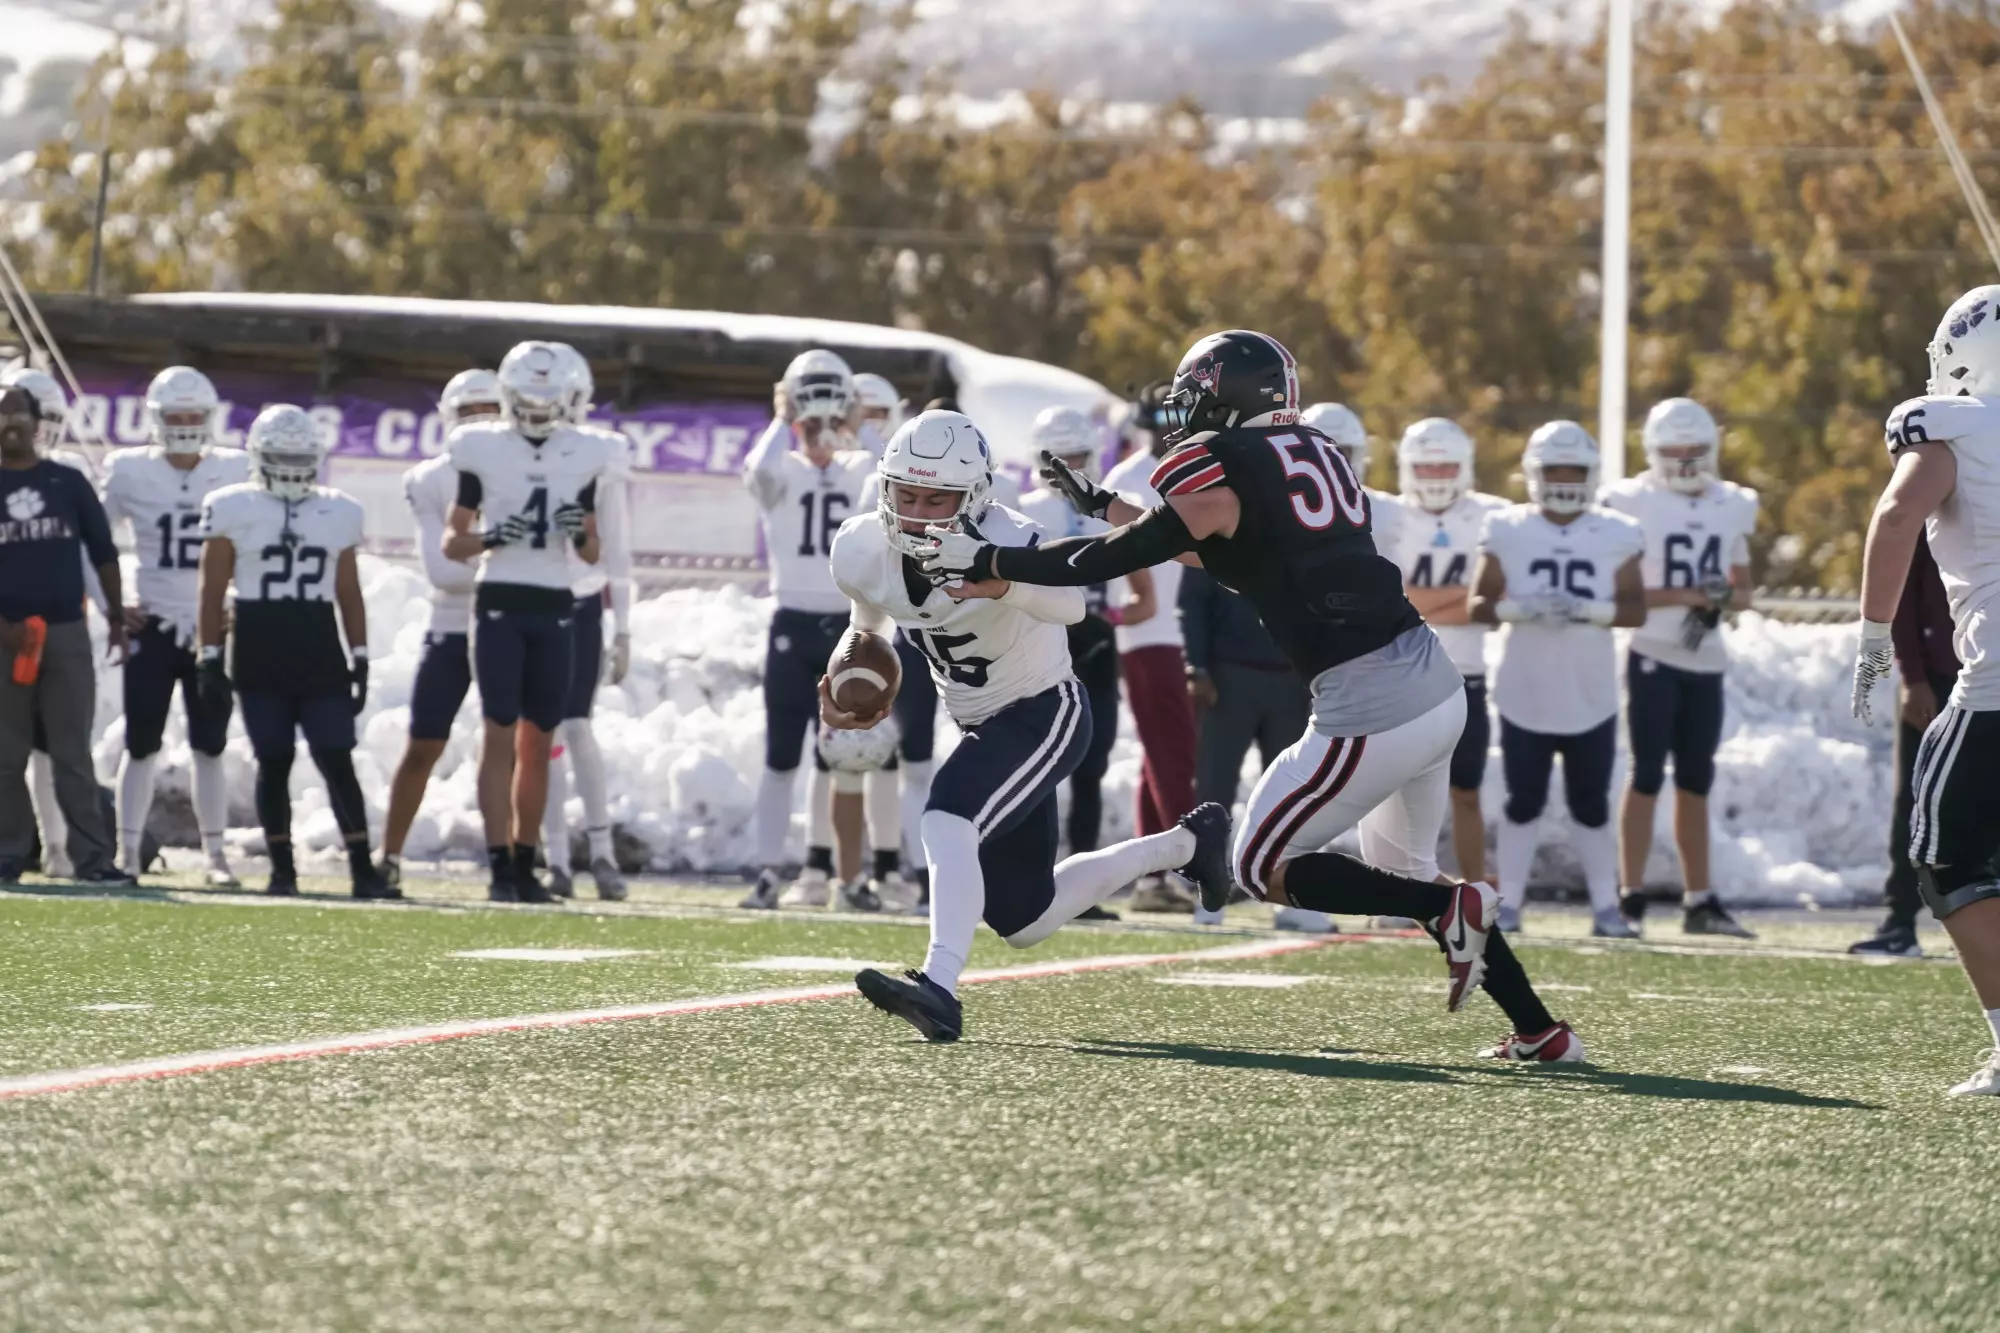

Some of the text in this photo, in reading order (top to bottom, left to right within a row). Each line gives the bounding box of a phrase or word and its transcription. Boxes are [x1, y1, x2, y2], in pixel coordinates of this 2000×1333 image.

[374, 408, 675, 468] COY
[1264, 433, 1367, 531] 50
[156, 513, 203, 568] 12
[520, 486, 549, 549] 4
[797, 491, 850, 557] 16
[261, 545, 328, 600] 22
[1664, 533, 1722, 589] 64
